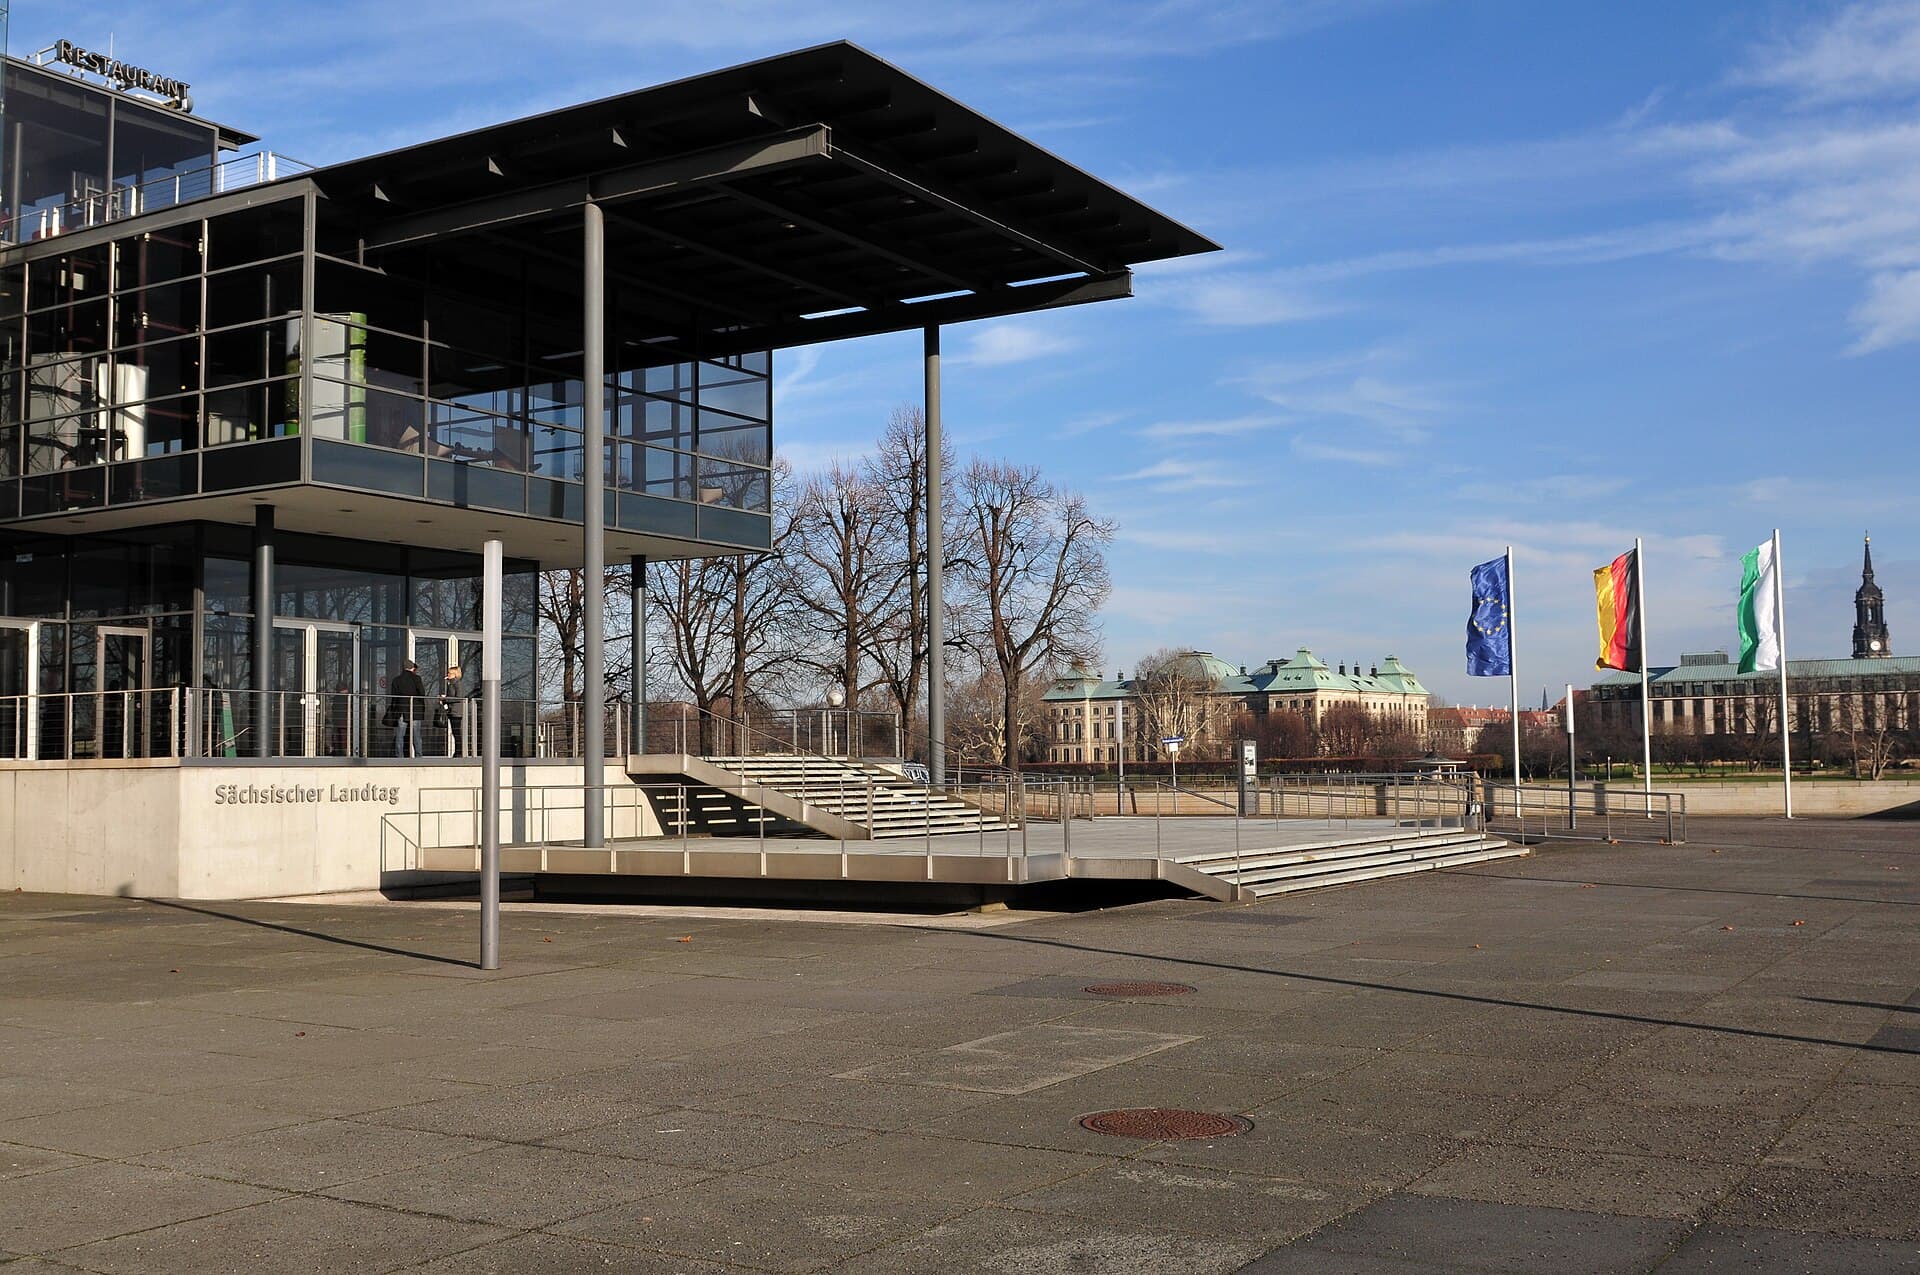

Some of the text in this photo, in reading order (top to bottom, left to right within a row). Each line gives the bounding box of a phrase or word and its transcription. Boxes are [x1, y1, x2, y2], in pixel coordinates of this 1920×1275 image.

[57, 39, 190, 99] RESTAURANT
[215, 782, 400, 805] Sächsischer Landtag
